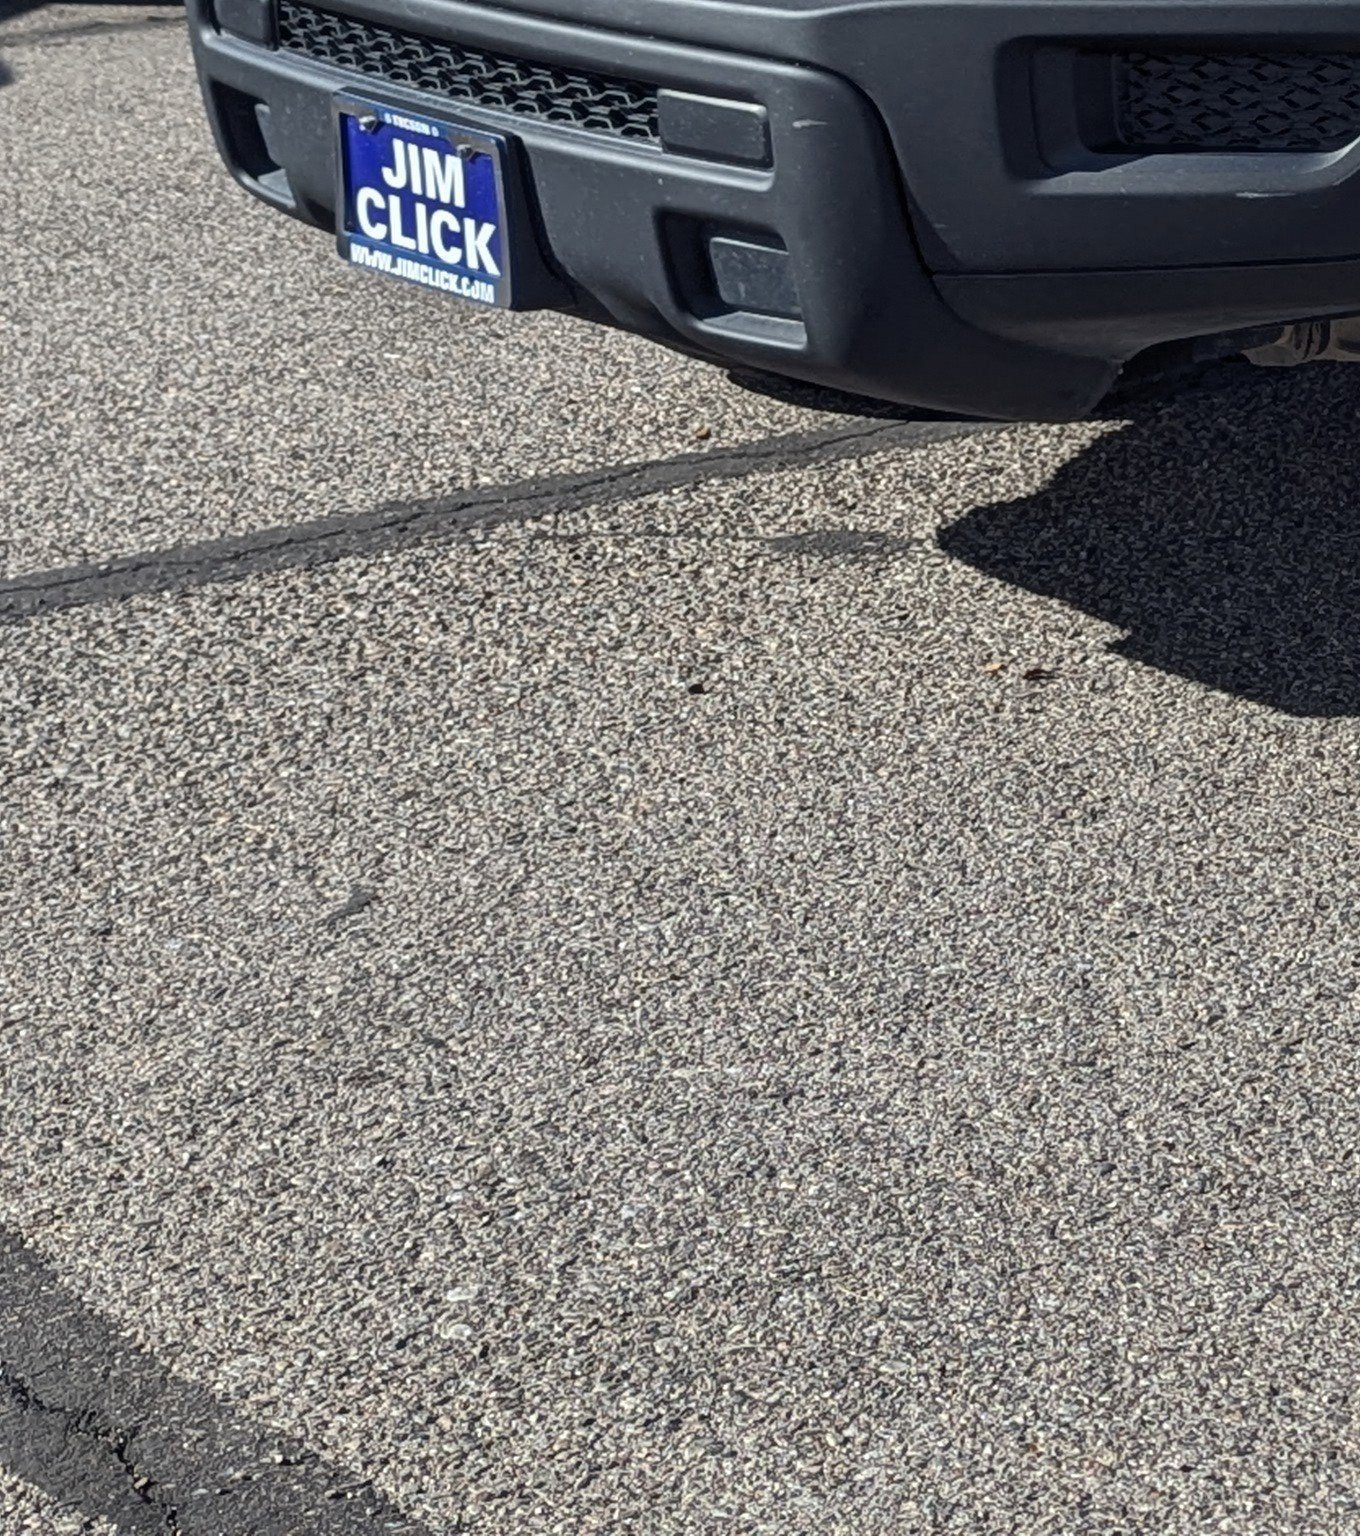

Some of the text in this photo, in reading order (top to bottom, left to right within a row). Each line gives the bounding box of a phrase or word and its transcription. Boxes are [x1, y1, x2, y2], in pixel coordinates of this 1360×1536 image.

[381, 138, 466, 209] JIM
[356, 186, 501, 277] CLICK
[350, 242, 495, 304] WWW.JIMCLICK.COM
